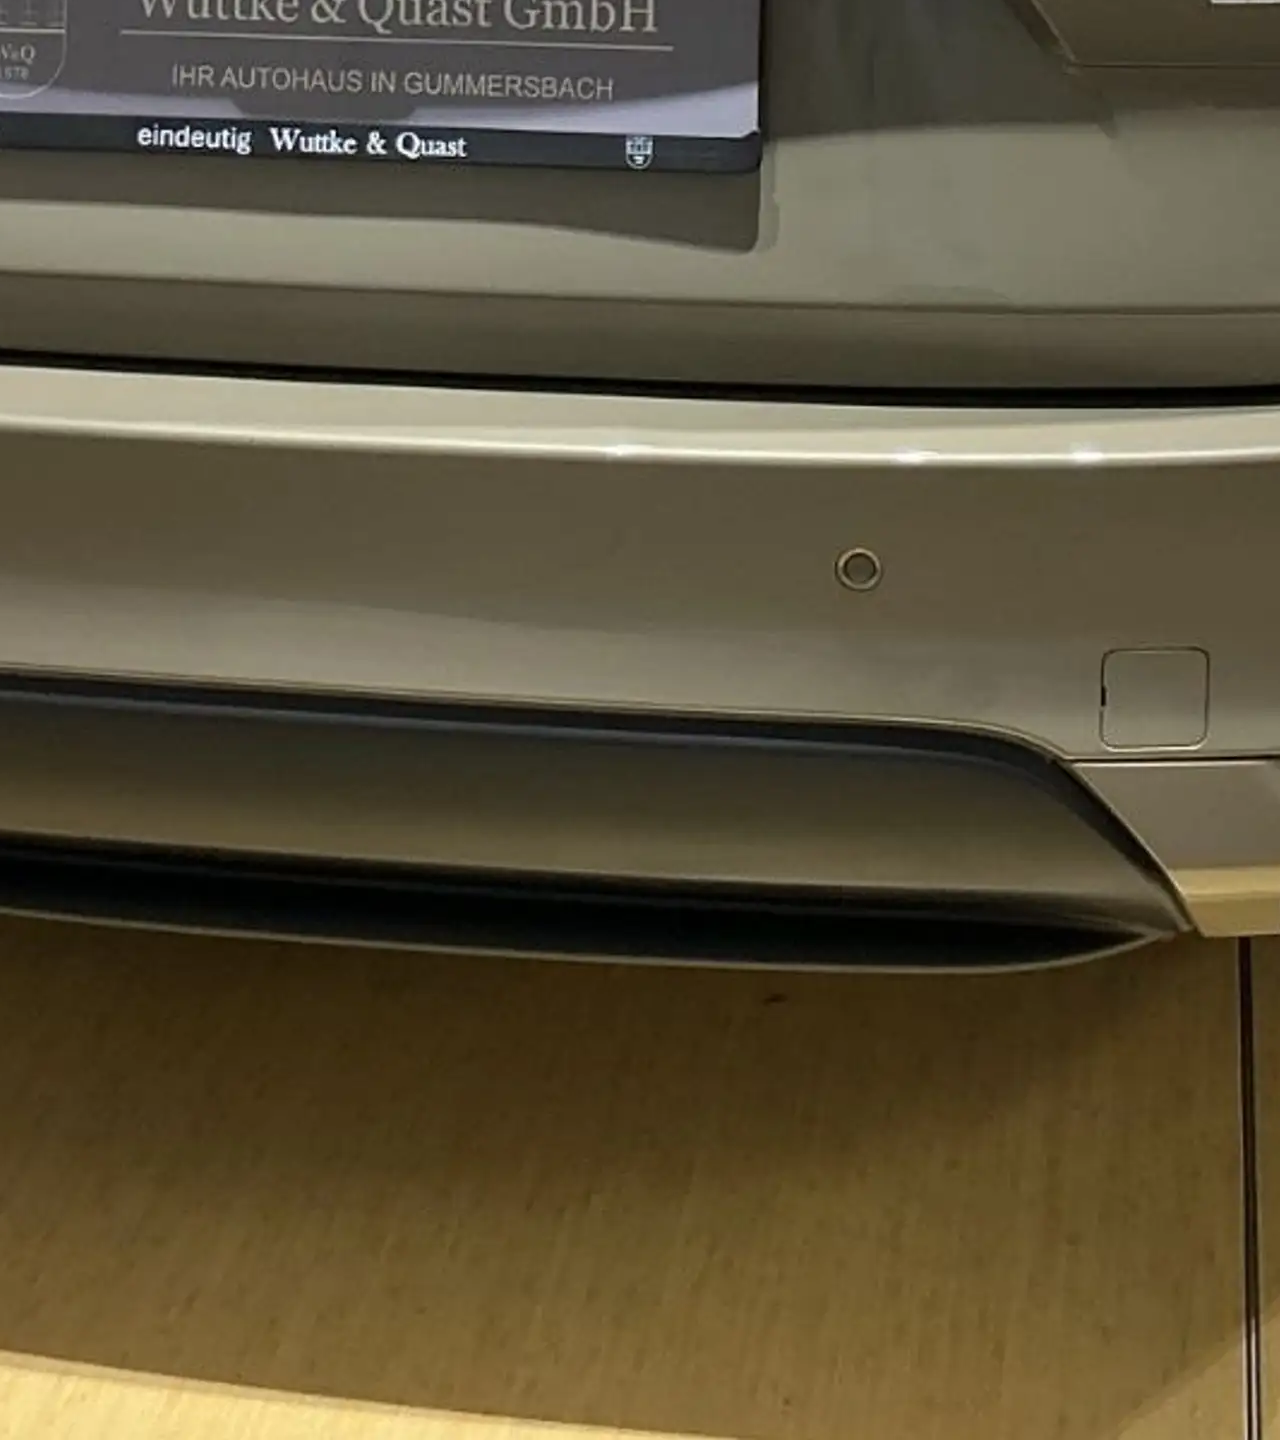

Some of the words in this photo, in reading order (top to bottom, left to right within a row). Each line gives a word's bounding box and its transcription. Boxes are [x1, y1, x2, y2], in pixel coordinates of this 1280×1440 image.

[171, 63, 216, 88] IHR
[219, 65, 364, 93] AUTOHAUS
[370, 68, 397, 94] IN
[403, 71, 615, 101] GUMMERSBACH
[136, 123, 253, 156] eindeutig
[269, 126, 358, 156] Wuttke
[366, 131, 388, 156] &
[394, 131, 468, 160] Quast
